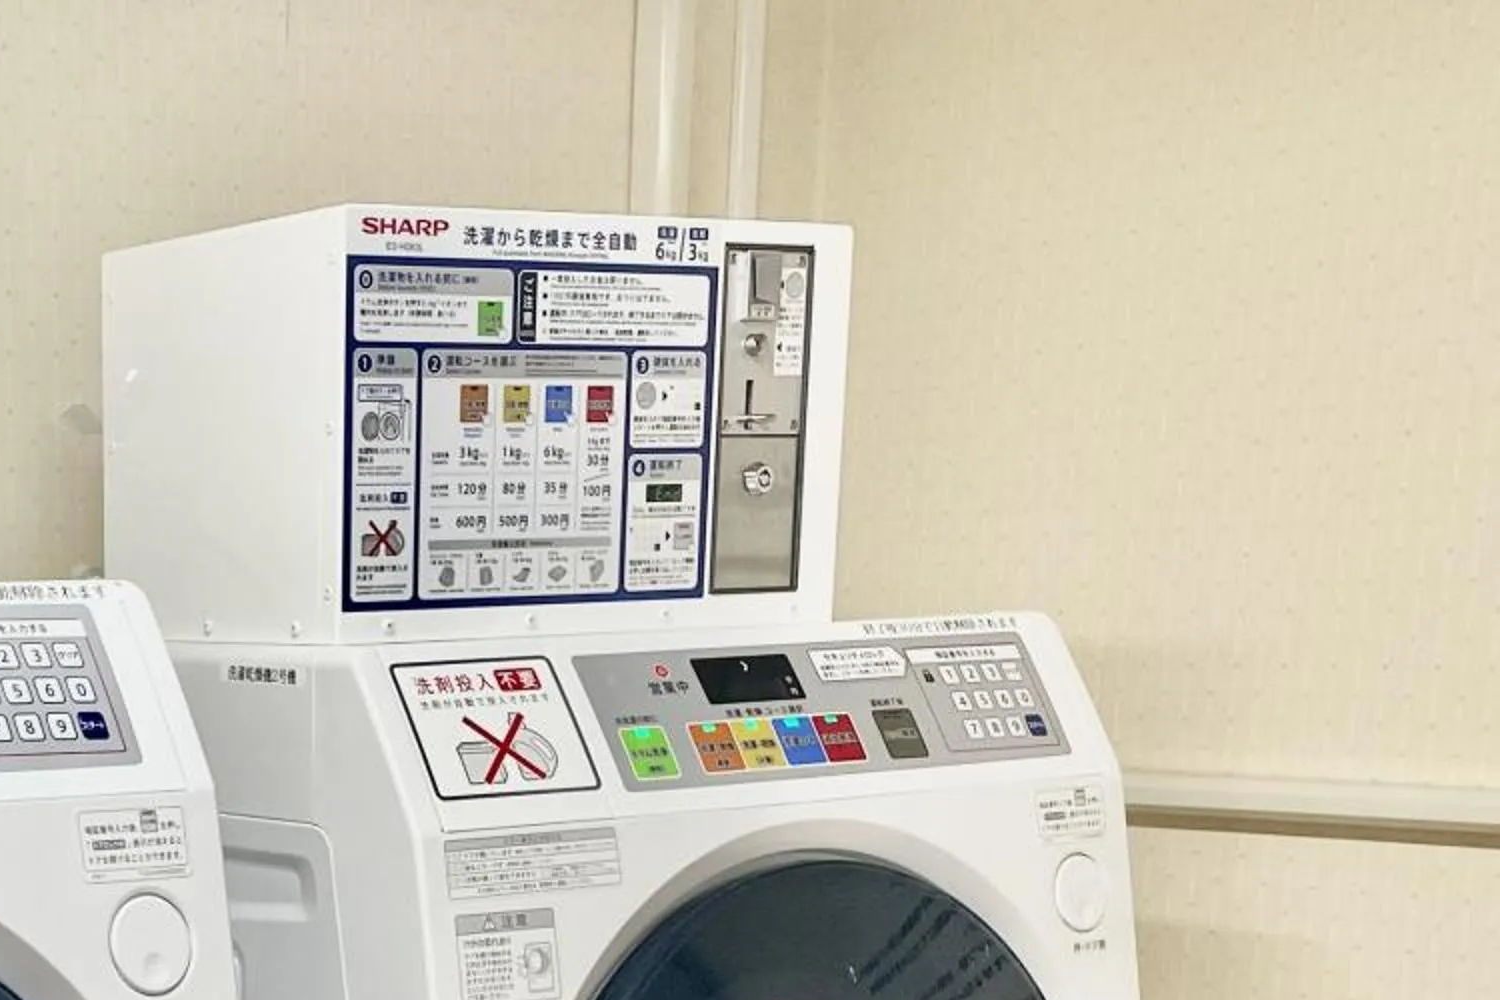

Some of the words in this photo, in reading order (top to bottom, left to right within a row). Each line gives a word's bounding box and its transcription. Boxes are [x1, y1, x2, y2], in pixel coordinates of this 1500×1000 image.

[361, 217, 449, 237] SHARP
[463, 225, 637, 251] 洗濯から乾燥まで全自動
[457, 482, 487, 495] 120分
[583, 485, 611, 497] 100円
[455, 515, 487, 528] 600円
[499, 515, 529, 528] 500円
[540, 514, 569, 527] 300円
[30, 649, 42, 663] 3
[946, 669, 954, 679] 1
[967, 667, 976, 678] 2
[987, 666, 996, 677] 3
[413, 673, 495, 695] 洗剤投入
[500, 670, 538, 690] 不要
[648, 680, 689, 696] 営業中
[11, 684, 23, 698] 5
[45, 683, 55, 697] 6
[76, 683, 87, 697] 0
[958, 696, 967, 705] 4
[979, 694, 988, 704] 5
[23, 720, 35, 735] 8
[56, 719, 67, 733] 9
[970, 721, 979, 732] 7
